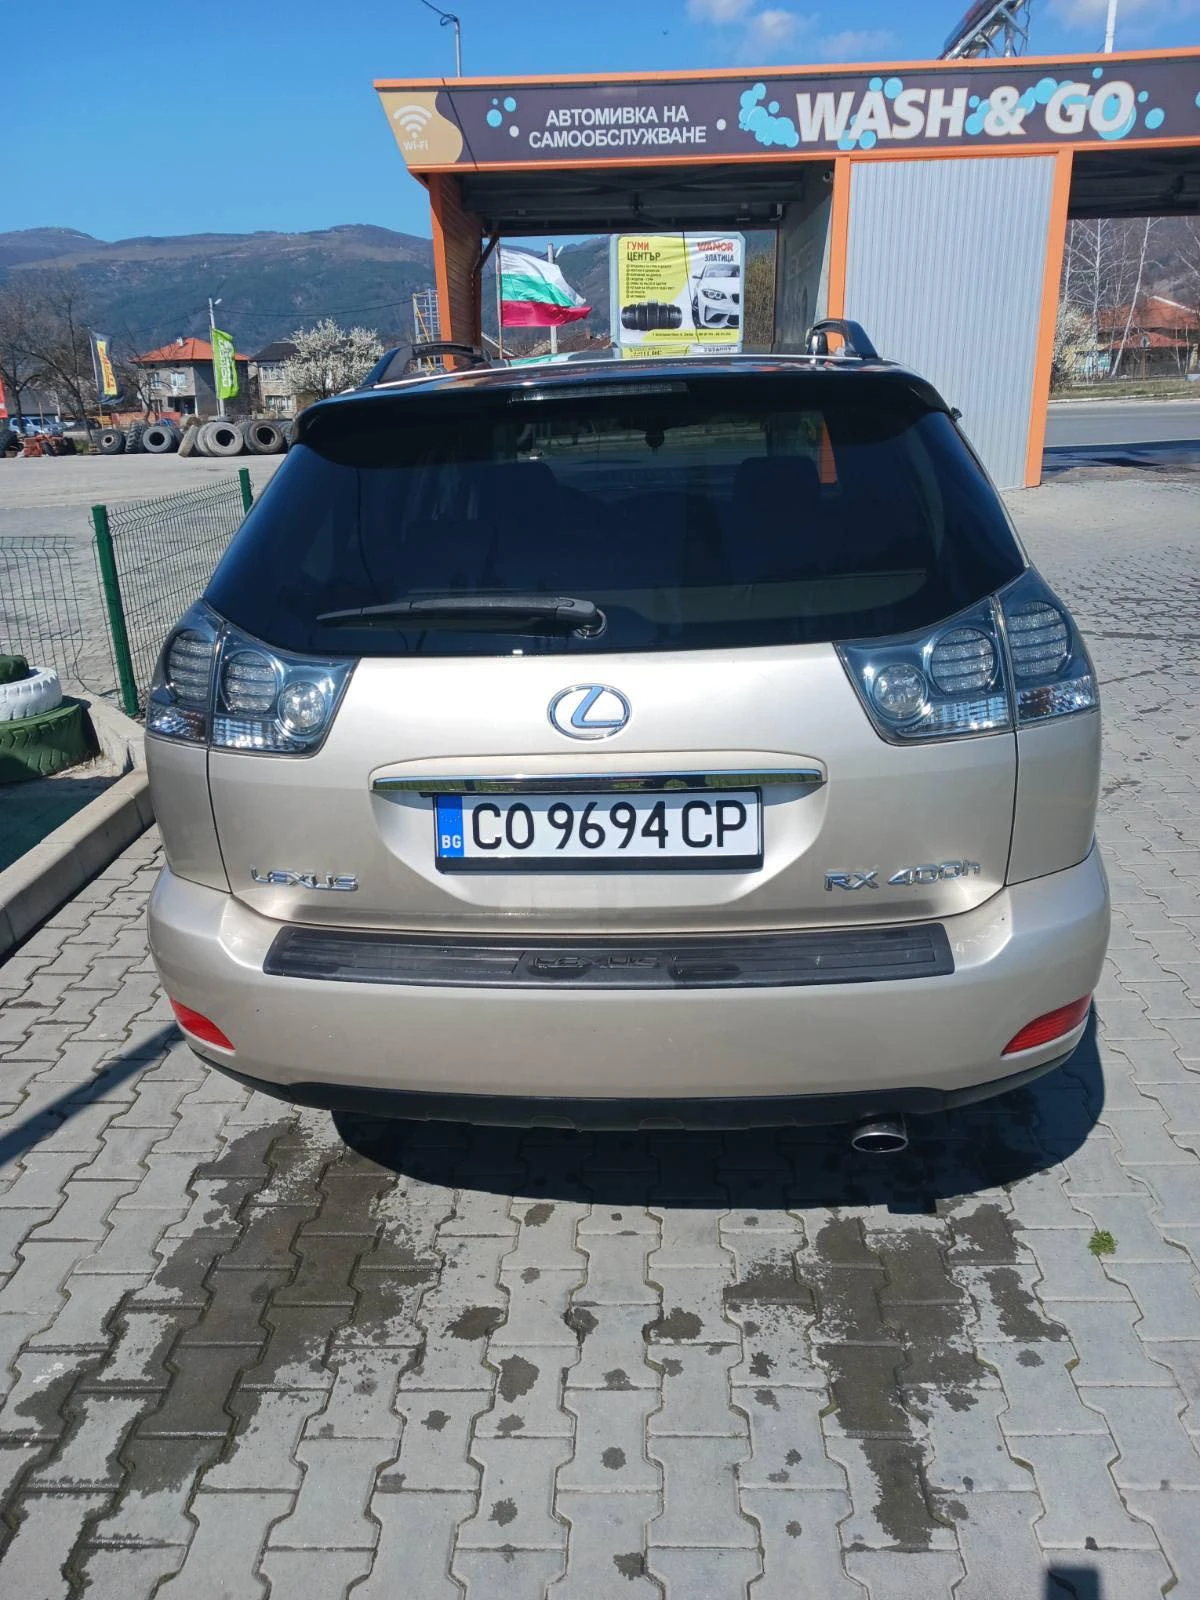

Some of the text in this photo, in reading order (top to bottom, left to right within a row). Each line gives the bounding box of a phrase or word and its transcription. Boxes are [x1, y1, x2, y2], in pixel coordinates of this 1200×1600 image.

[546, 105, 689, 127] АВТОМИВКА НА
[795, 80, 1136, 143] WASH & GO
[528, 126, 707, 149] САМООБСЛУЖВАНЕ
[627, 241, 650, 251] ГУМИ
[627, 252, 661, 262] ЦЕНТЪР
[704, 253, 735, 263] ЗЛАТИЦА
[471, 799, 748, 850] CO 9694 CP
[441, 834, 463, 849] BG
[249, 863, 360, 893] LEXUS
[824, 857, 981, 892] RX 400h
[530, 955, 663, 970] LEXUS
